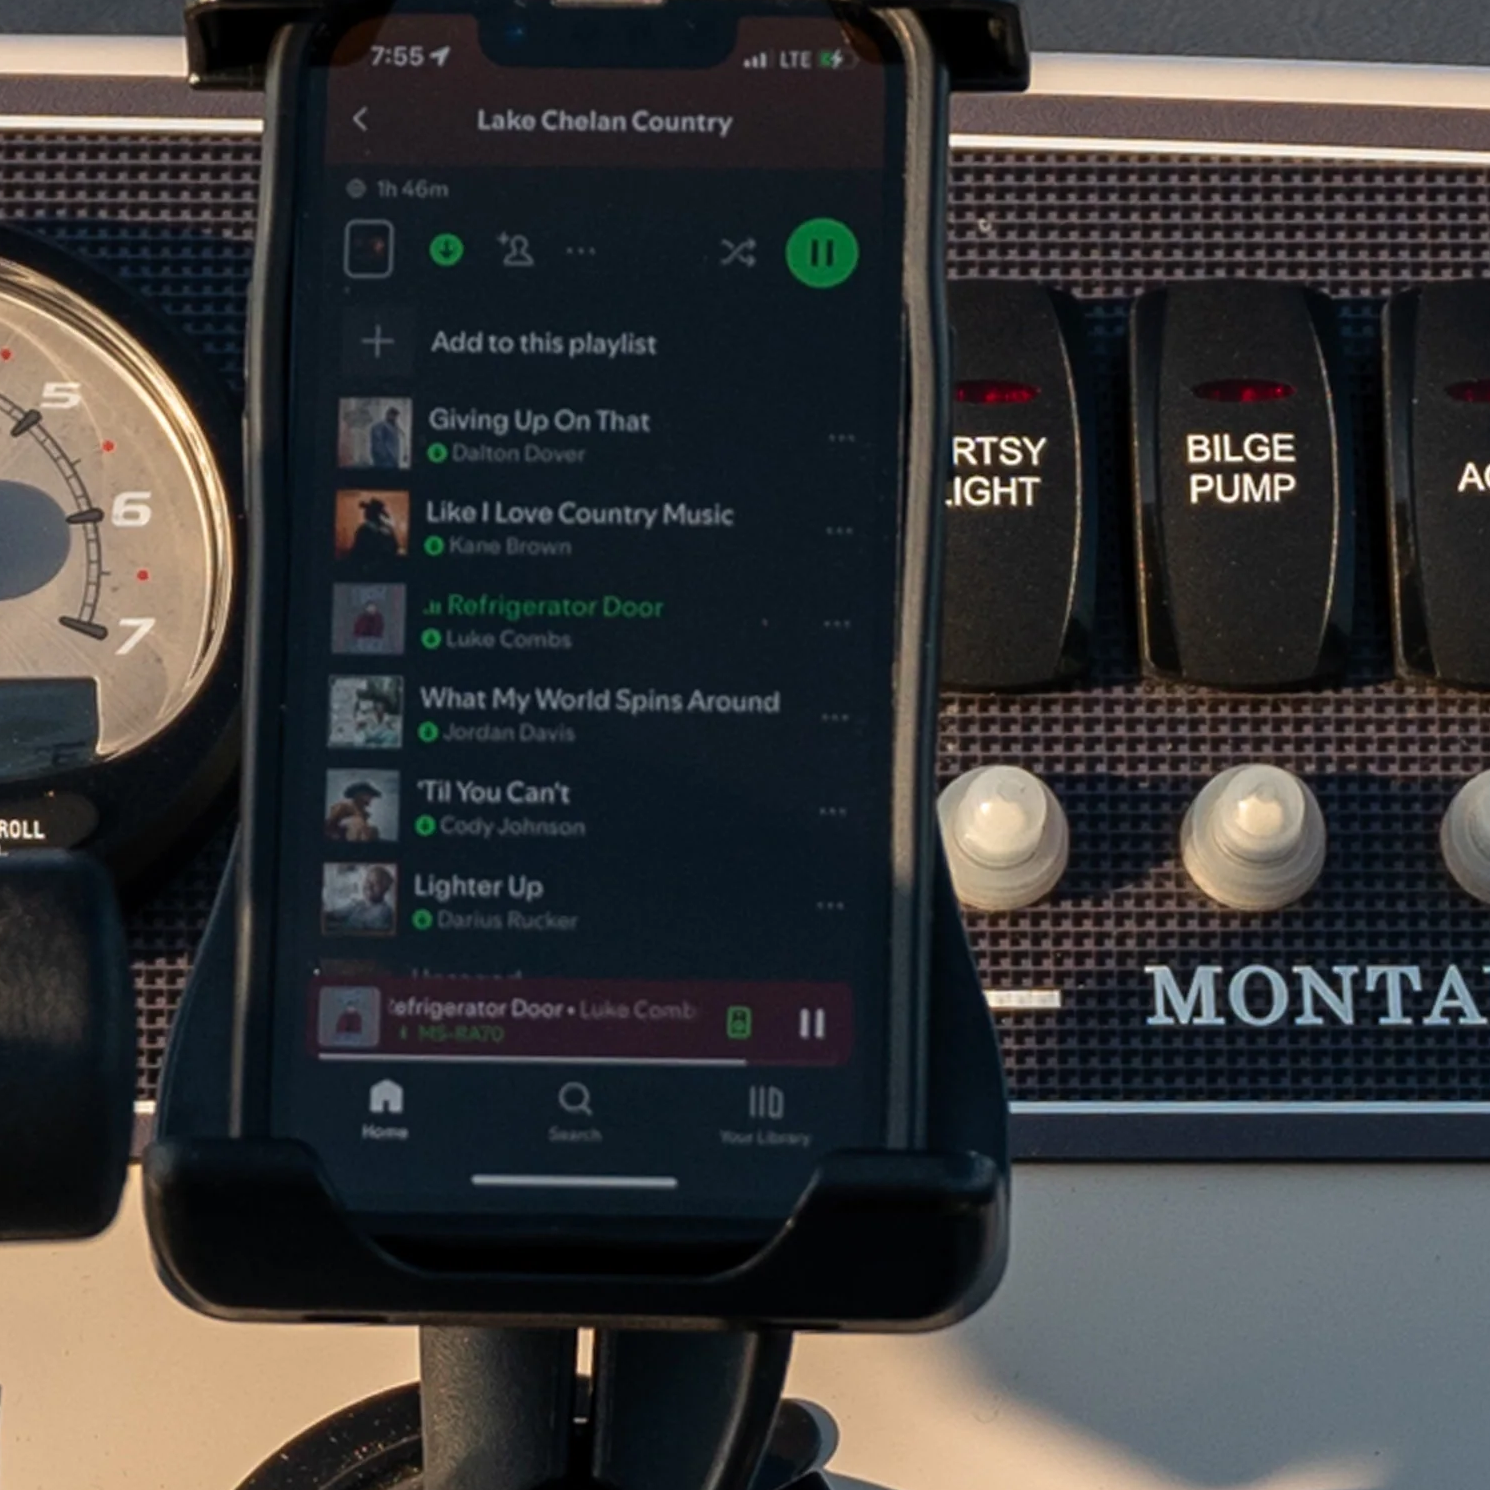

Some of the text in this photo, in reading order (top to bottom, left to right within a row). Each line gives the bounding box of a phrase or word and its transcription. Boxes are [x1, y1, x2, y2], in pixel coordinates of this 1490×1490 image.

[370, 45, 424, 67] 7:55
[779, 50, 811, 69] LTE
[478, 110, 733, 137] Lake Chelan Country
[376, 179, 449, 199] 1h 46m
[431, 331, 658, 363] Add to this playlist
[40, 382, 82, 408] 5
[429, 408, 651, 436] Giving Up On That
[451, 443, 586, 464] Dalton Dover
[952, 436, 1047, 466] RTSY
[1186, 434, 1296, 464] BILGE
[945, 476, 1041, 507] IGHT
[1190, 474, 1297, 503] PUMP
[110, 491, 153, 527] 6
[426, 501, 734, 530] Like I Love Country Music
[449, 536, 572, 557] Kane Brown
[448, 594, 664, 622] Refrigerator Door
[115, 618, 155, 655] 7
[446, 629, 572, 649] Luke Combs
[420, 687, 780, 716] What My World Spins Around
[442, 723, 575, 743] Jordan Davis
[456, 781, 502, 804] You
[440, 816, 586, 840] Cody Johnson
[414, 873, 544, 902] Lighter Up
[437, 910, 578, 931] Darius Rucker
[511, 999, 562, 1020] Door
[579, 1001, 630, 1021] Luke
[362, 1124, 409, 1141] Home
[548, 1125, 602, 1143] Search
[720, 1129, 811, 1149] Your Library
